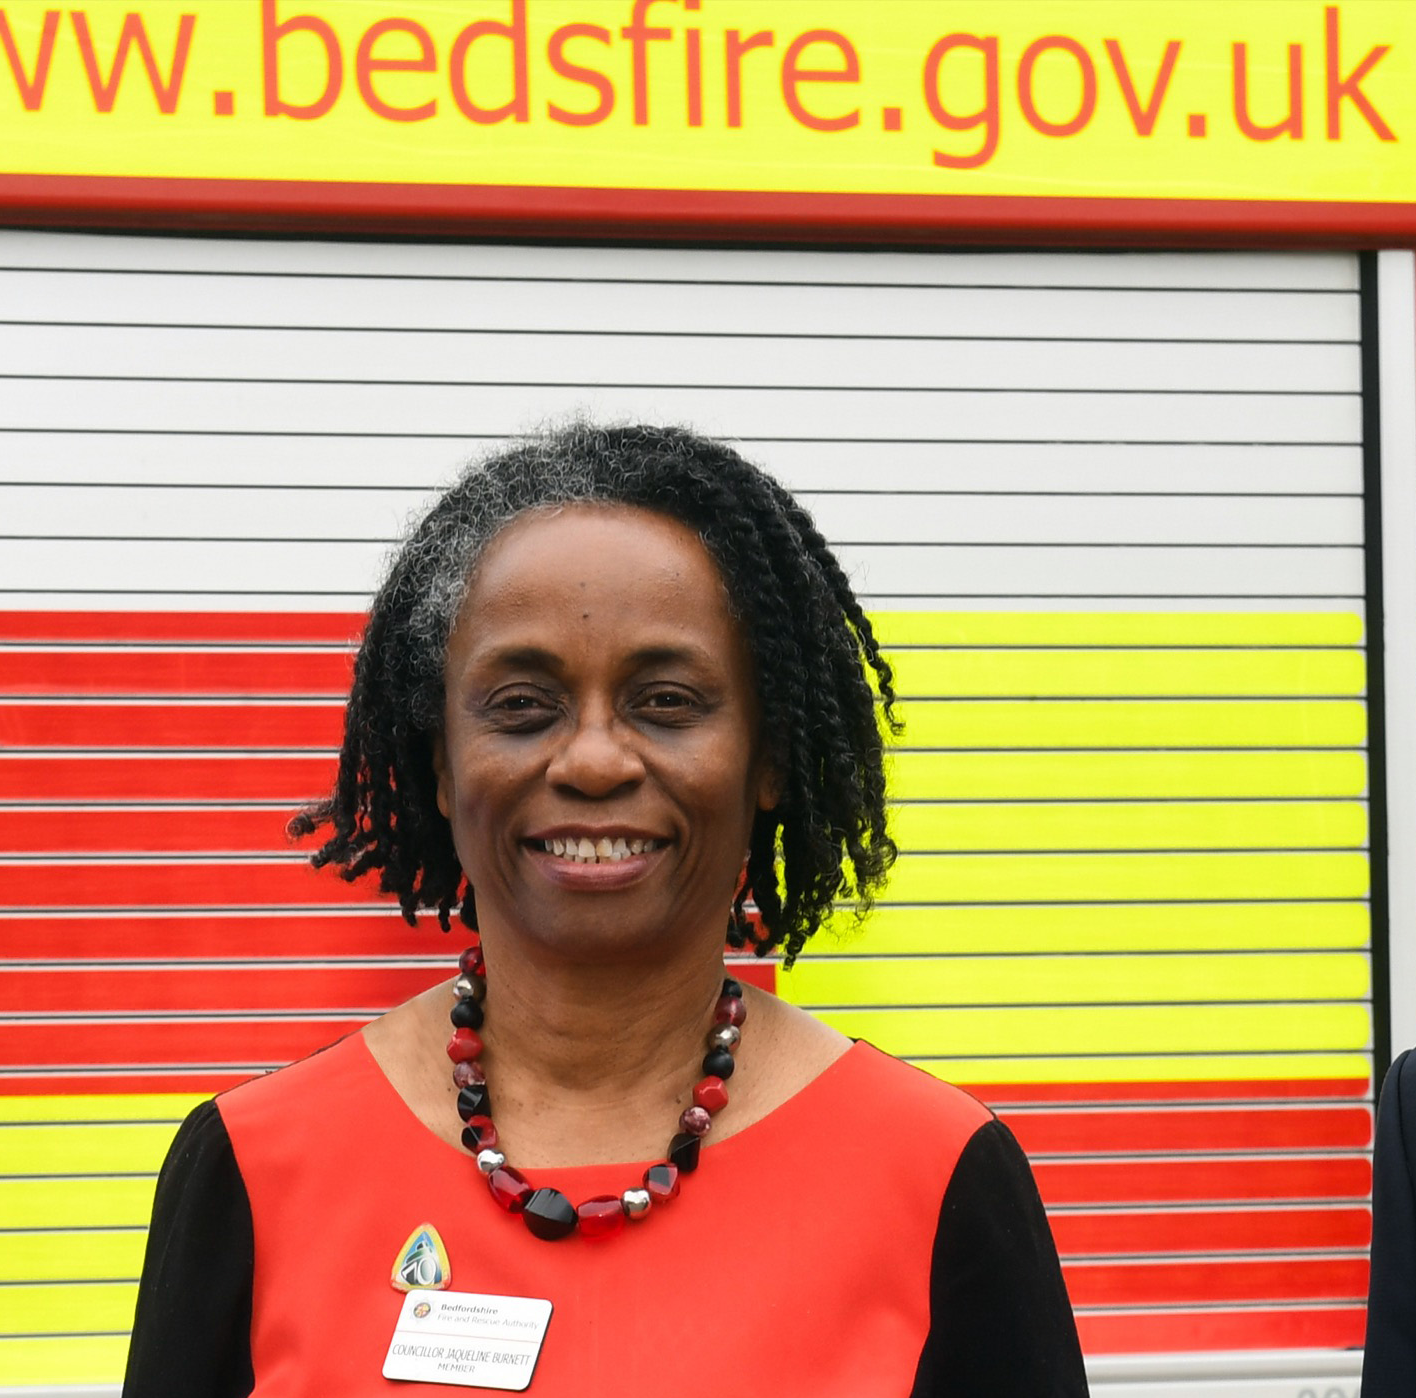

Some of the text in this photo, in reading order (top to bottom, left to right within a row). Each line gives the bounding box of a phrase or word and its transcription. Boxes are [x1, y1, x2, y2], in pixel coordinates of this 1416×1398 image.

[441, 1303, 498, 1315] Bedfordshire
[437, 1314, 539, 1330] Fire and Rescue Authority
[392, 1344, 531, 1366] COUNCILLOR JAQUELINE BURNETT
[437, 1363, 475, 1373] MEMBER
